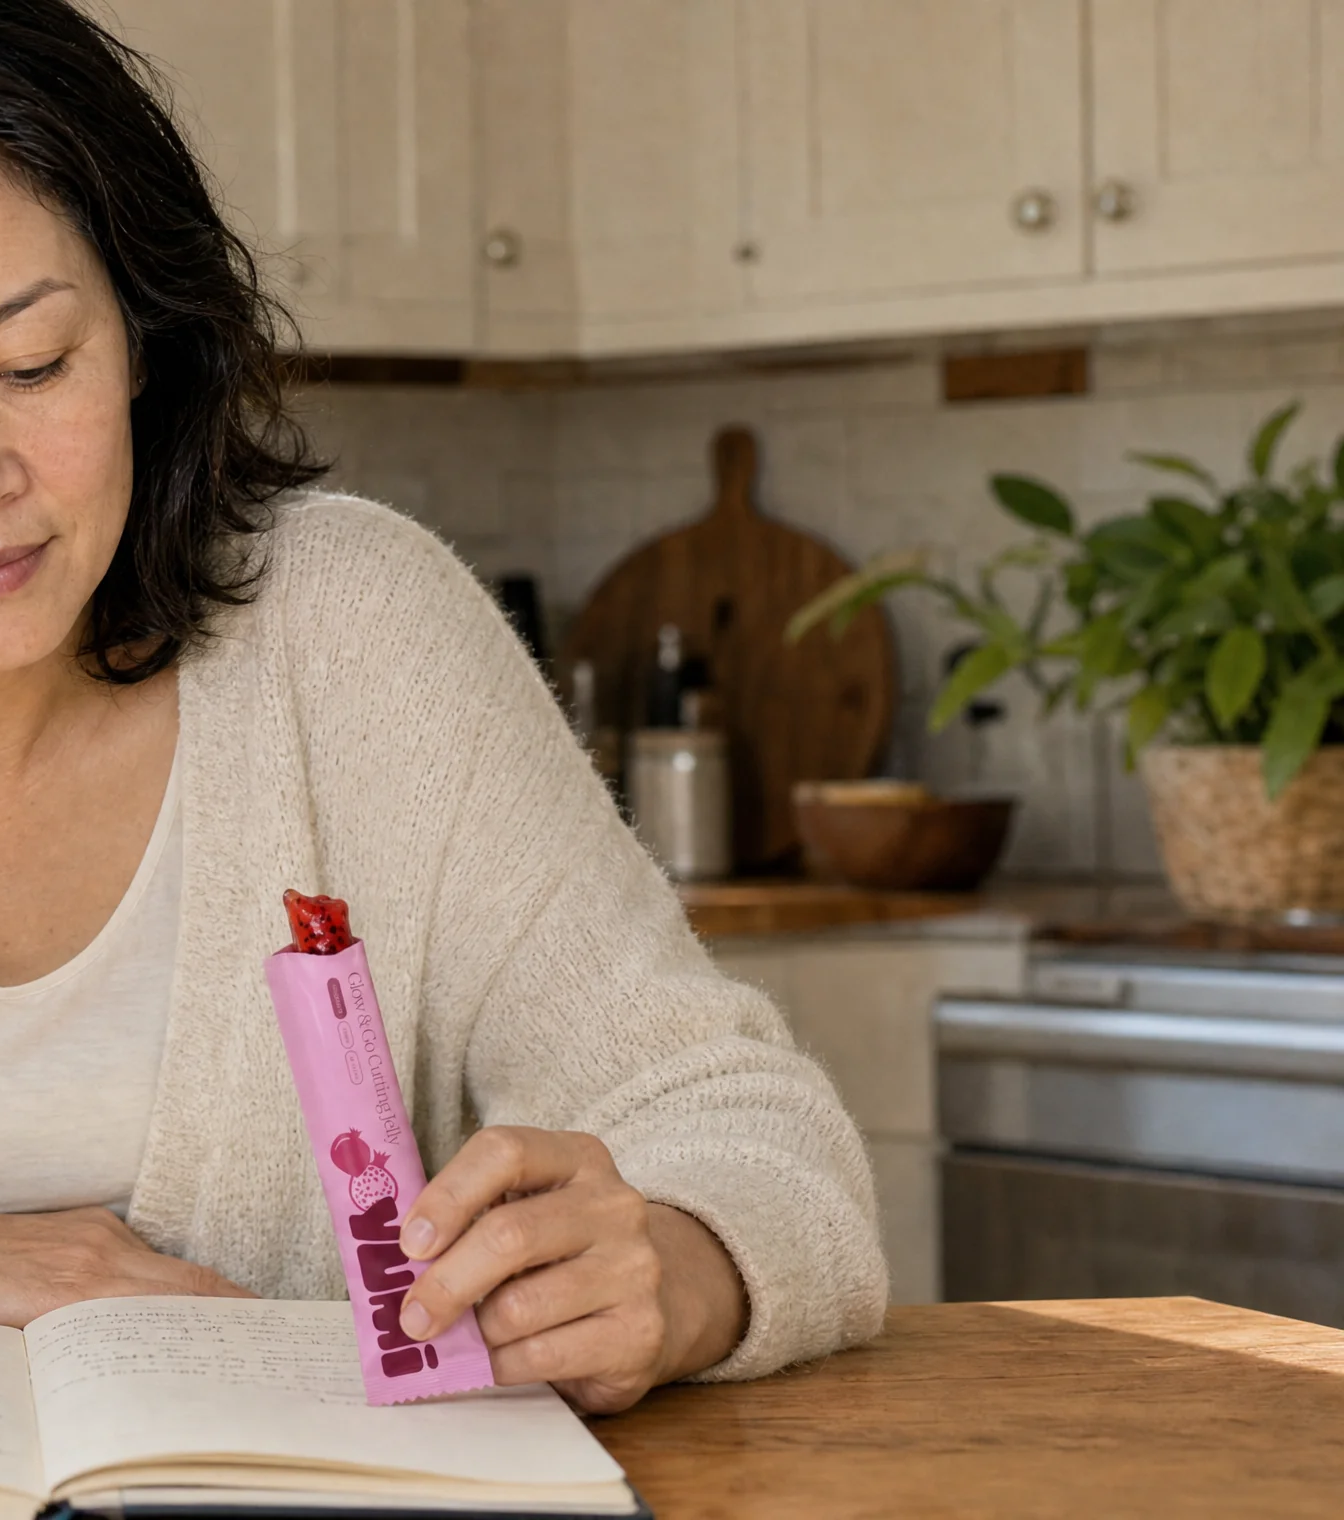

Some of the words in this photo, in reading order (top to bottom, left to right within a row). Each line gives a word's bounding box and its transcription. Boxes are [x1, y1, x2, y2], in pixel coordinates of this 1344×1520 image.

[348, 972, 365, 1011] Glow
[357, 1014, 372, 1029] &
[361, 1029, 377, 1053] Go
[367, 1054, 391, 1114] Cutting
[378, 1114, 402, 1146] Jelly
